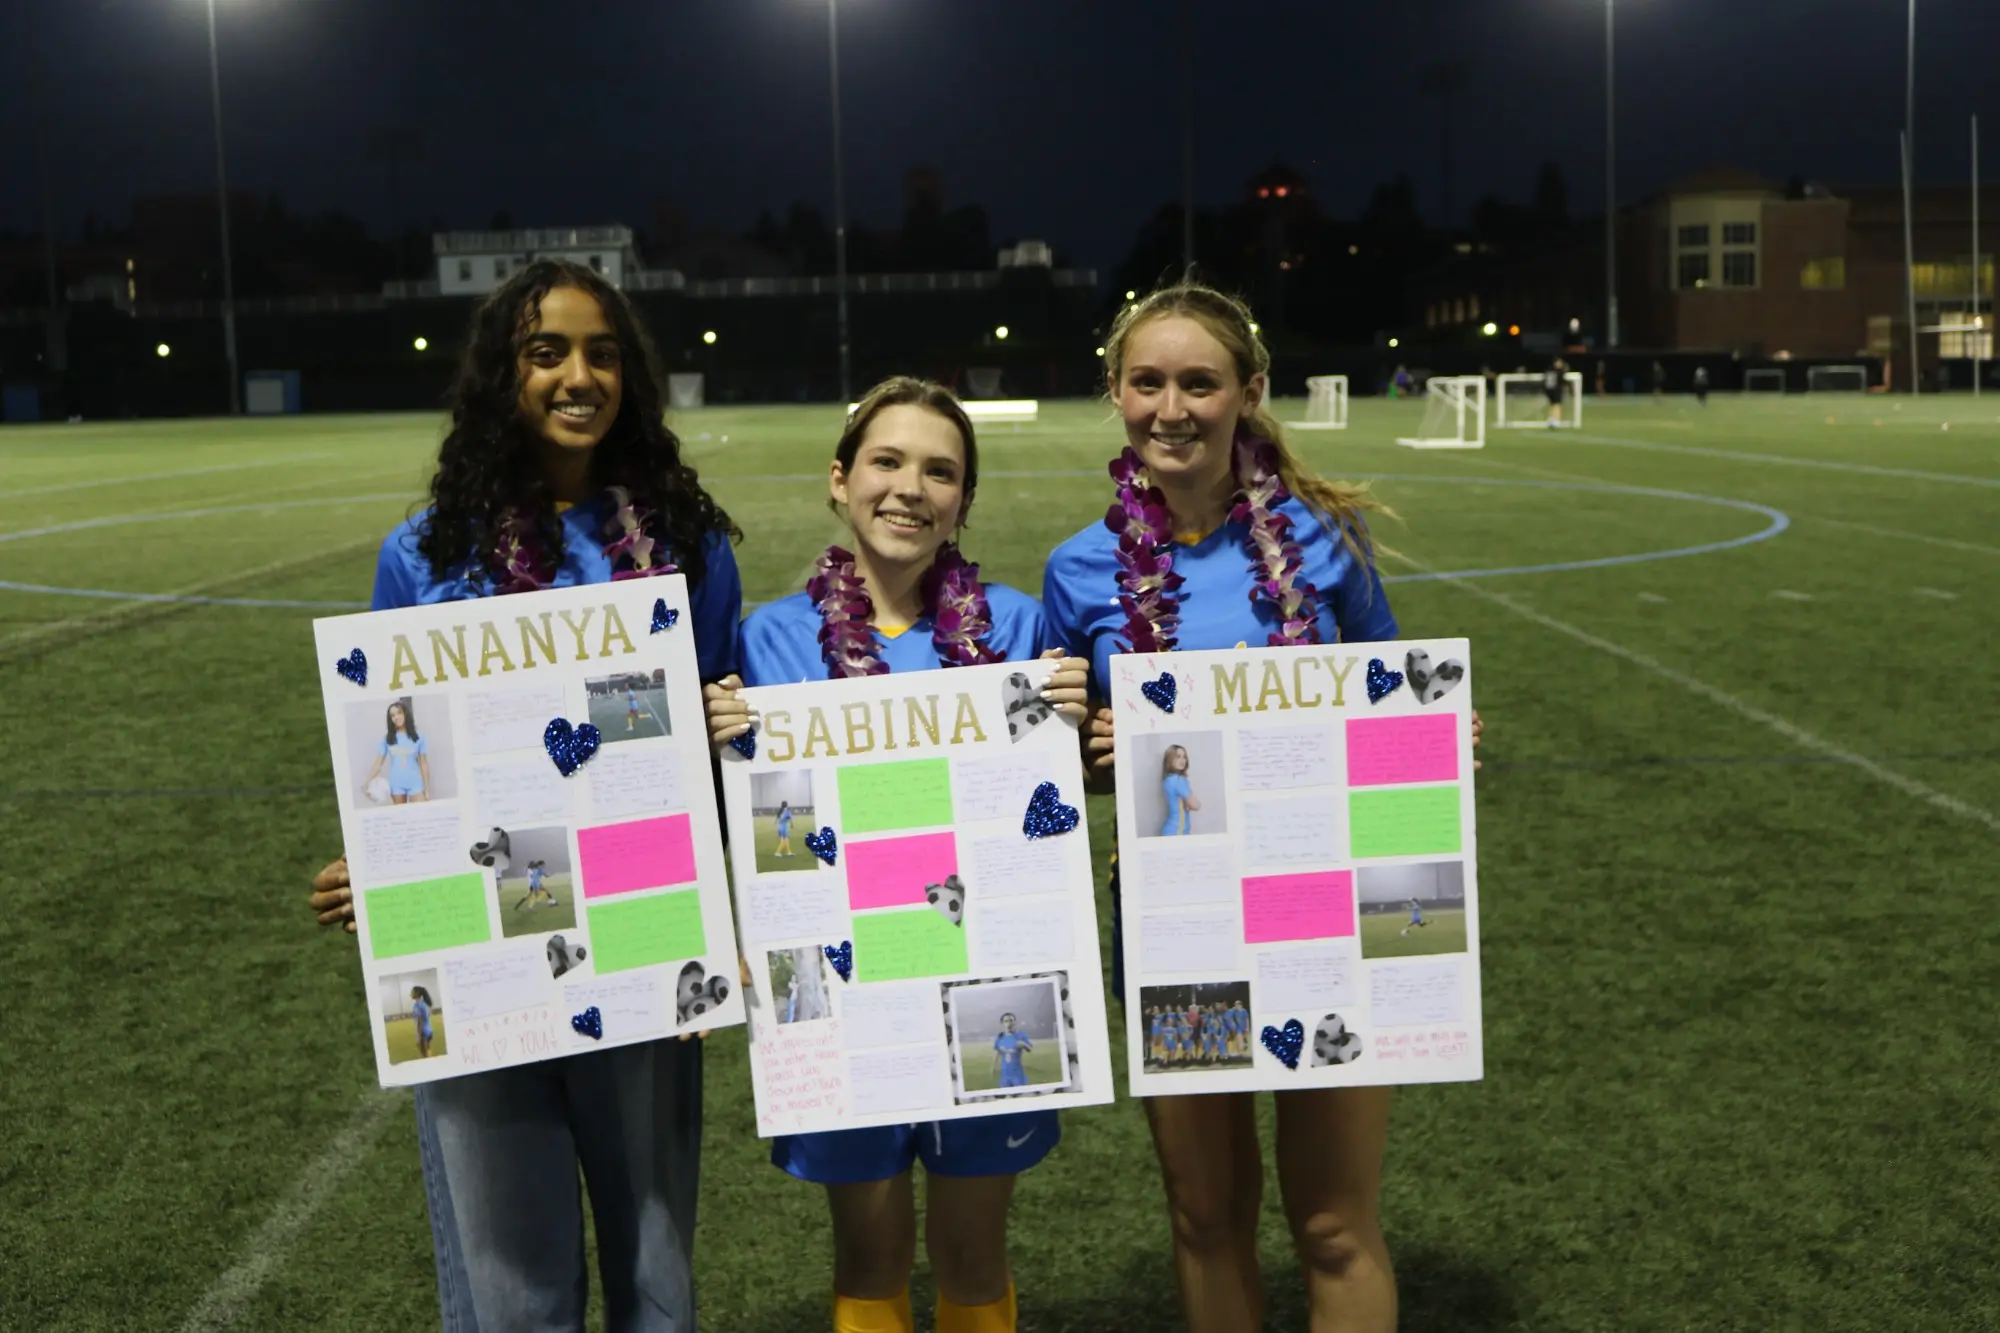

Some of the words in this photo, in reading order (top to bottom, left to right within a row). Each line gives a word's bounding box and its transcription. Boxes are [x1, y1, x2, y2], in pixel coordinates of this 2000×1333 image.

[388, 603, 636, 690] ANANYA
[1210, 656, 1359, 714] MACY
[764, 692, 987, 763] SABINA
